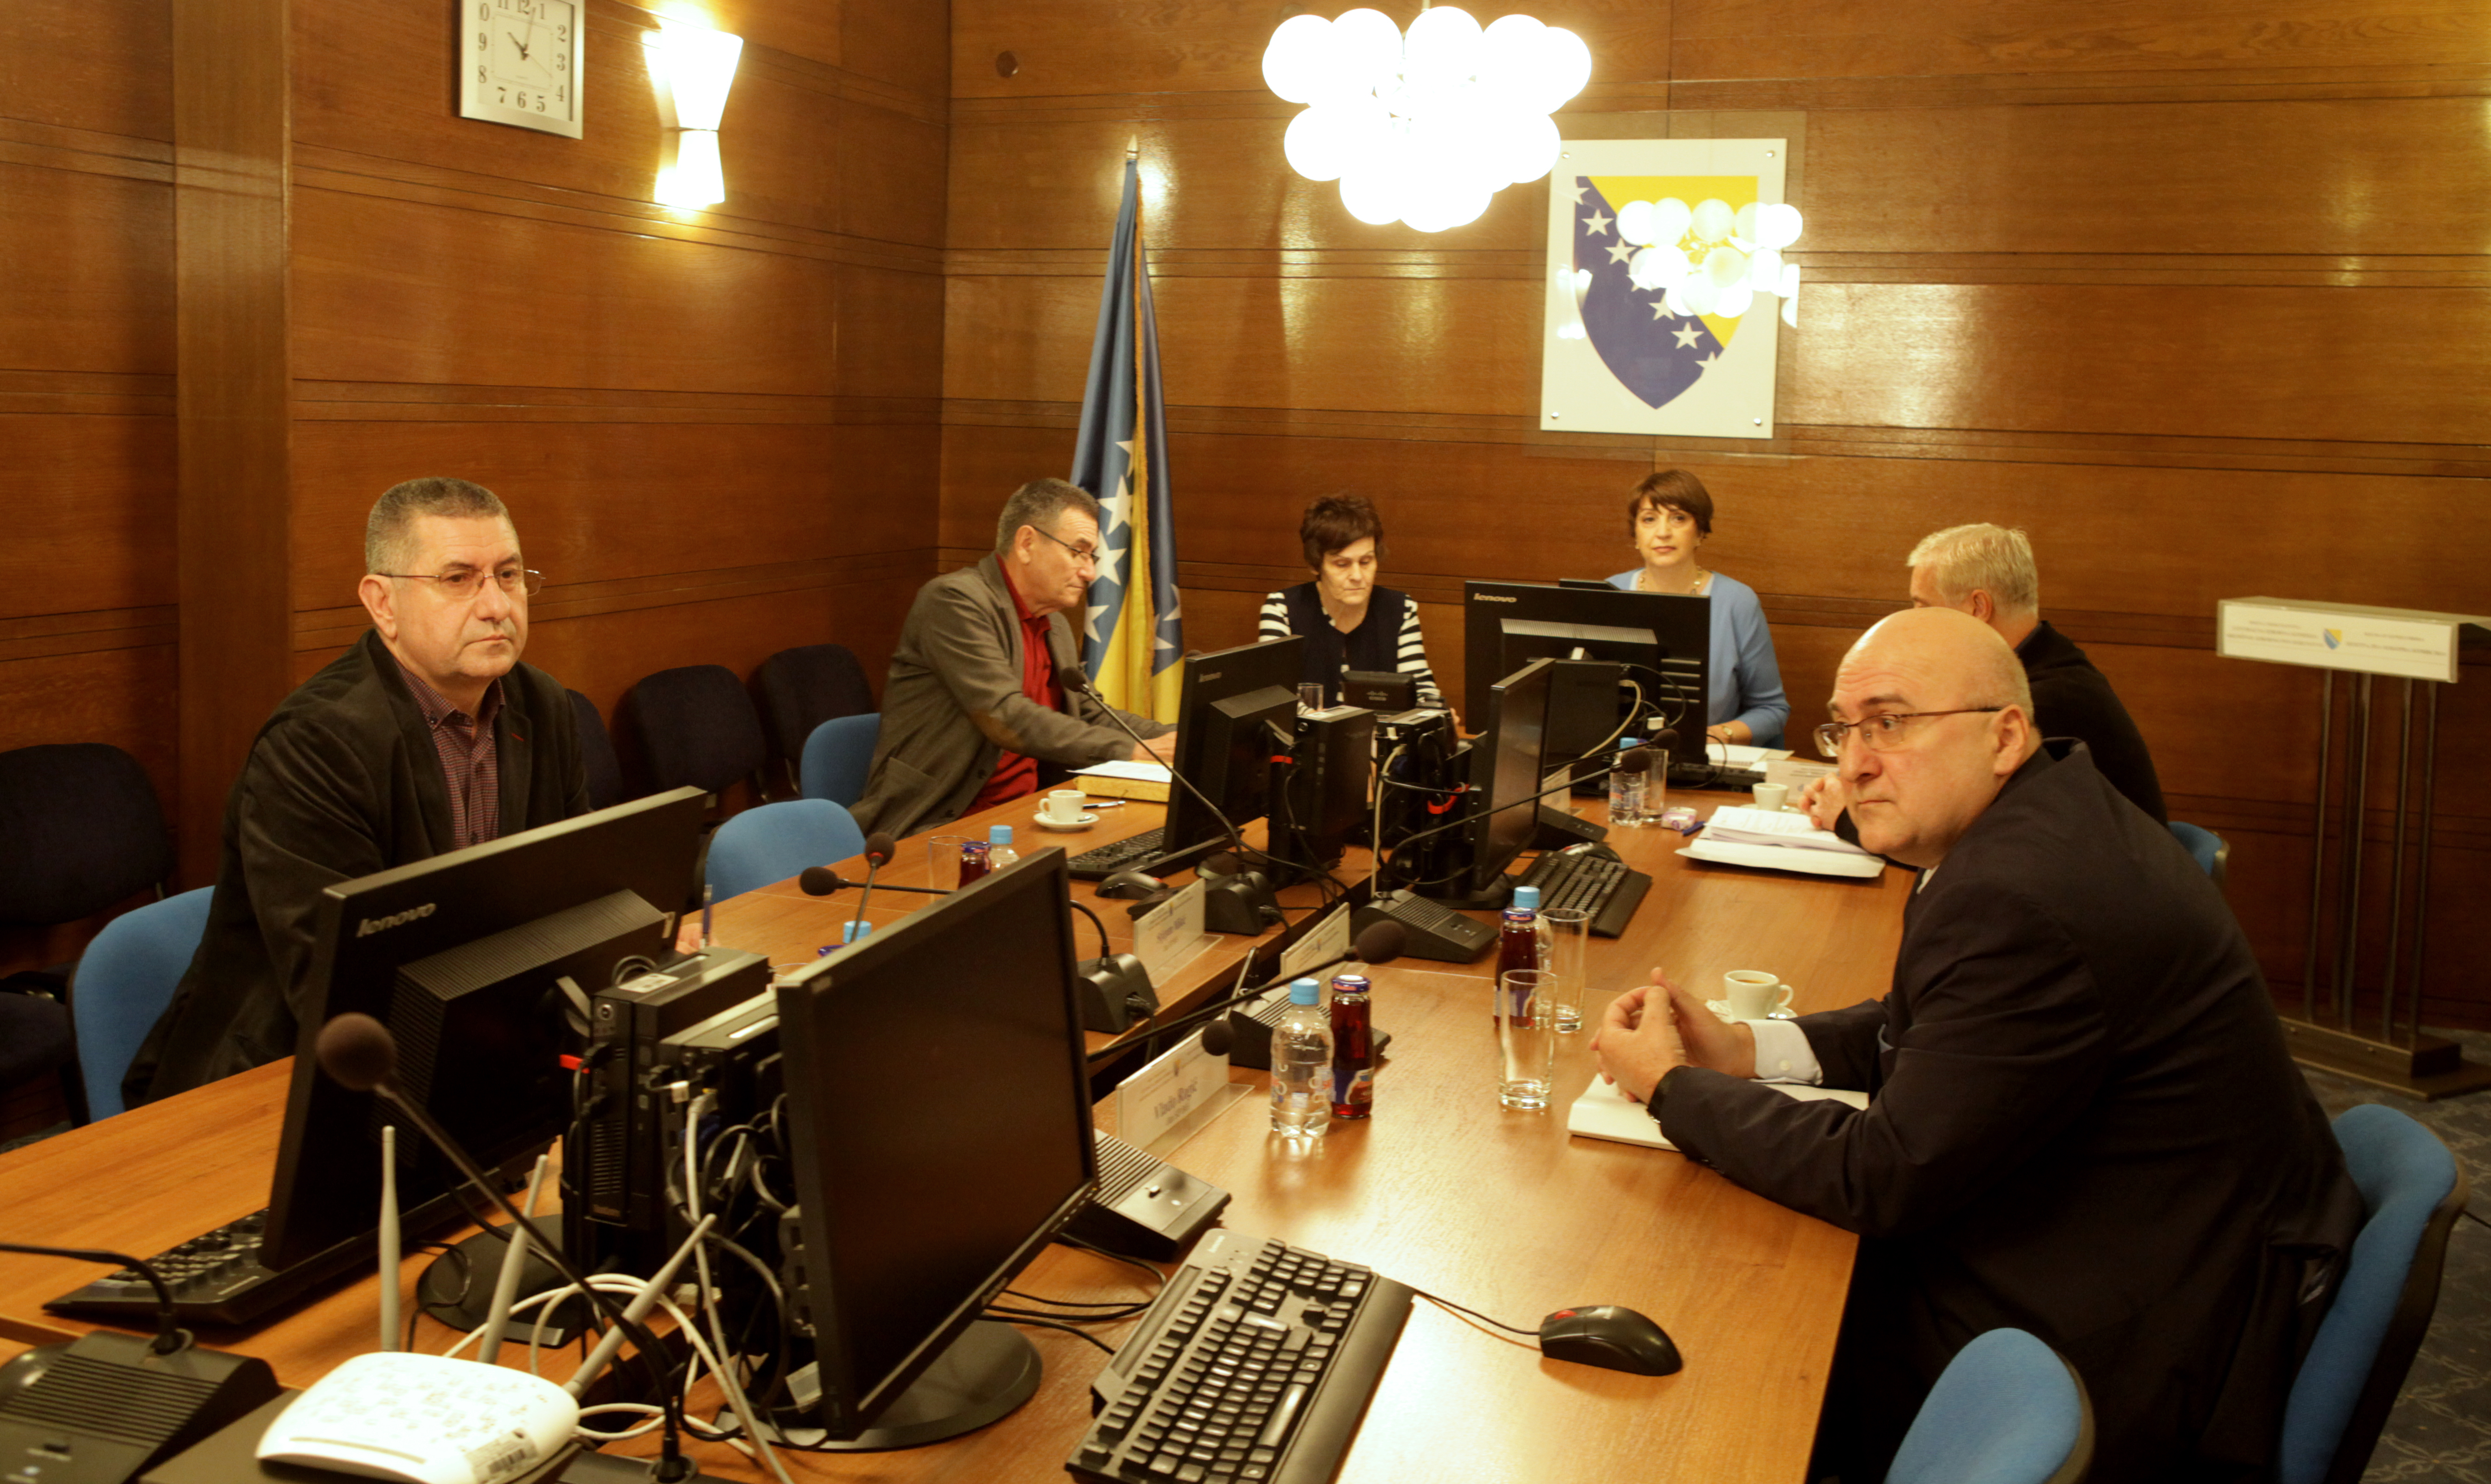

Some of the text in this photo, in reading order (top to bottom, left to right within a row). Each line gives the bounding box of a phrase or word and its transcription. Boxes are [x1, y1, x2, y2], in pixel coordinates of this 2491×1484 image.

[517, 0, 530, 15] 12
[540, 3, 545, 20] 1
[478, 33, 487, 51] 9
[557, 25, 566, 42] 2
[556, 53, 566, 71] 3
[478, 65, 487, 83] 8
[497, 86, 507, 103] 7
[517, 91, 527, 108] 6
[556, 85, 565, 102] 4
[537, 95, 546, 112] 5
[1473, 593, 1517, 603] lenovo
[356, 903, 437, 937] lenovo
